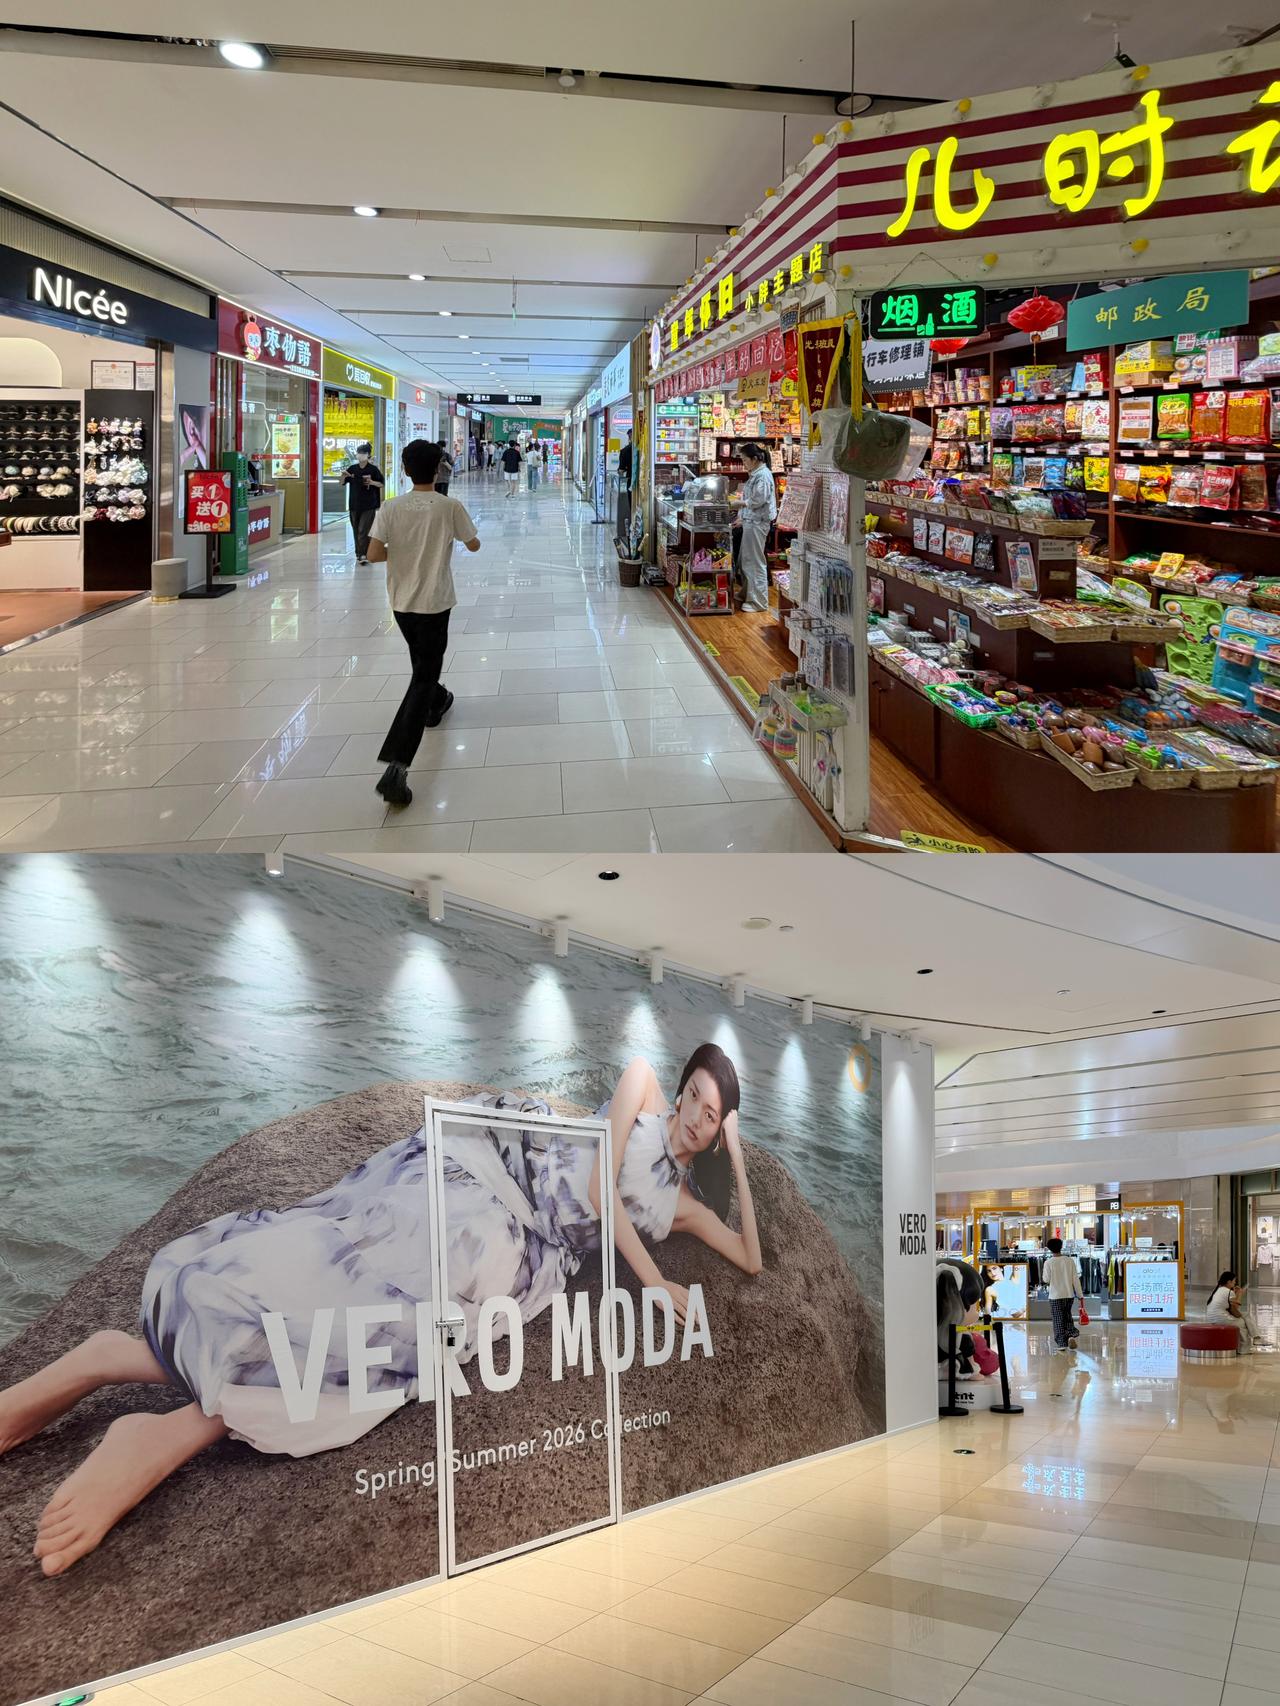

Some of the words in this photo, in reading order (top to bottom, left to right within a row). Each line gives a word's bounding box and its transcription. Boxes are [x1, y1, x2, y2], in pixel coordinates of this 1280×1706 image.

[881, 289, 978, 327] 烟酒
[1095, 286, 1210, 330] 邮政局
[862, 341, 926, 368] 行车修理铺
[899, 1213, 927, 1233] VERO
[899, 1235, 927, 1255] MODA
[261, 1295, 524, 1424] VERO
[551, 1283, 715, 1382] MODA
[354, 1461, 436, 1499] Spring
[450, 1437, 537, 1473] Summer
[543, 1422, 585, 1451] 2026
[591, 1408, 671, 1440] Colection
